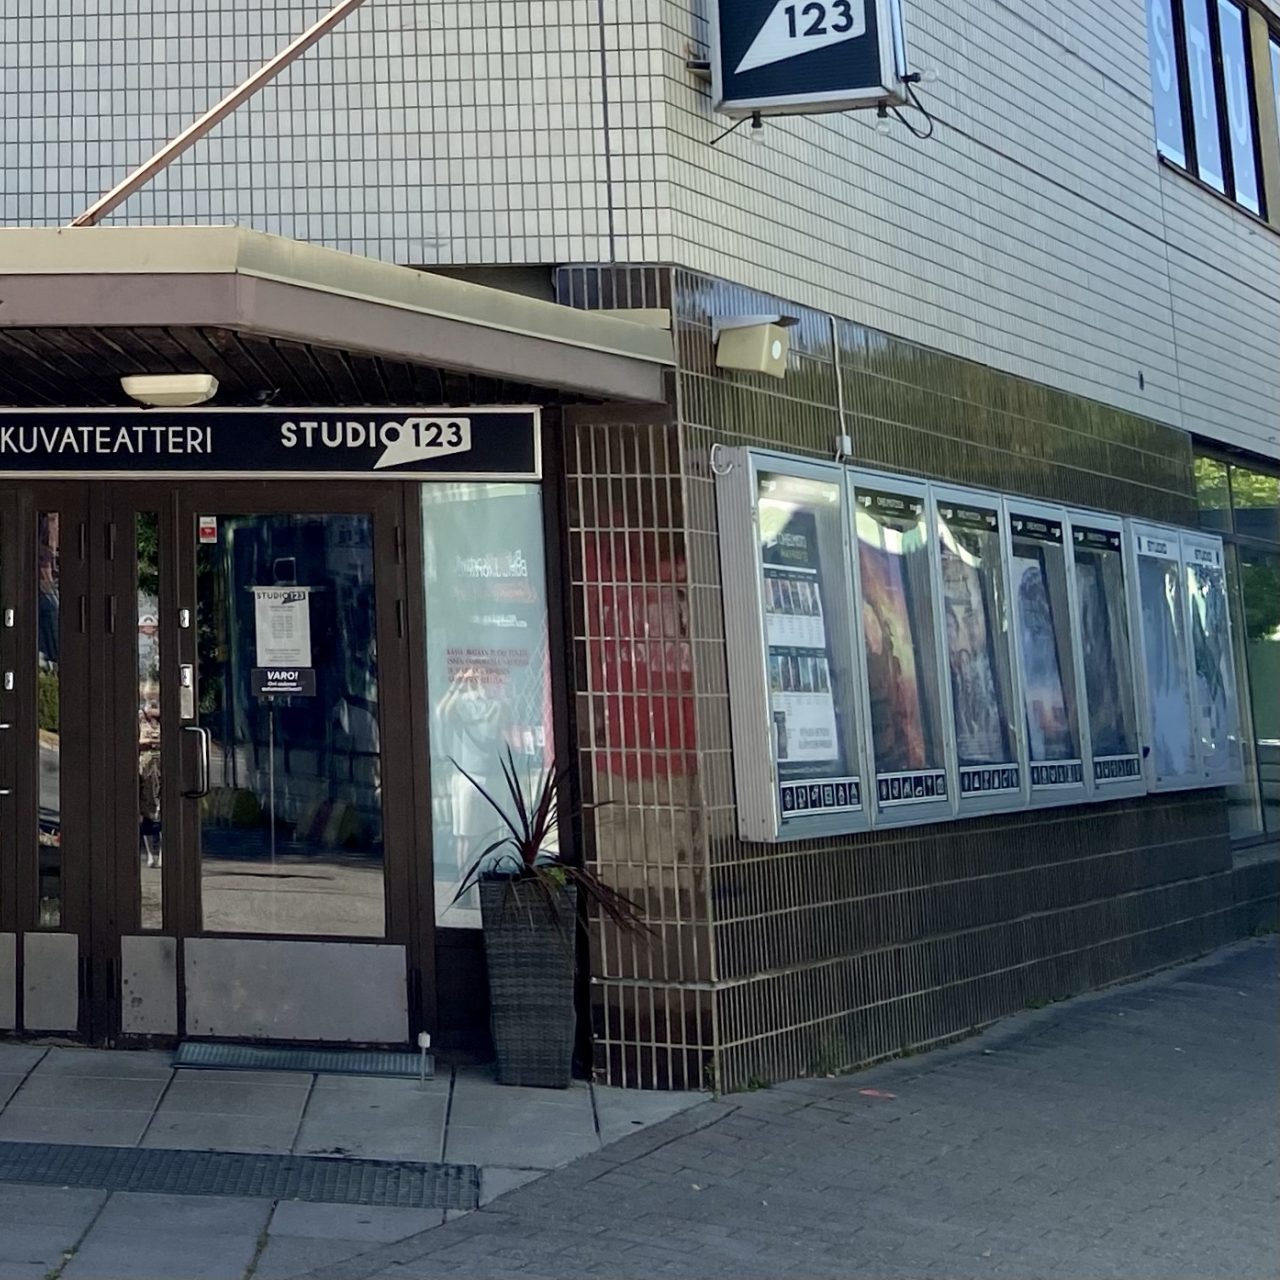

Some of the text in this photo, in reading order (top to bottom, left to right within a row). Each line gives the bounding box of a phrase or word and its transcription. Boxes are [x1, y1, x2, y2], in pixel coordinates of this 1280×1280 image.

[784, 0, 854, 38] 123
[281, 421, 403, 447] STUDIO
[267, 671, 299, 681] VARO!
